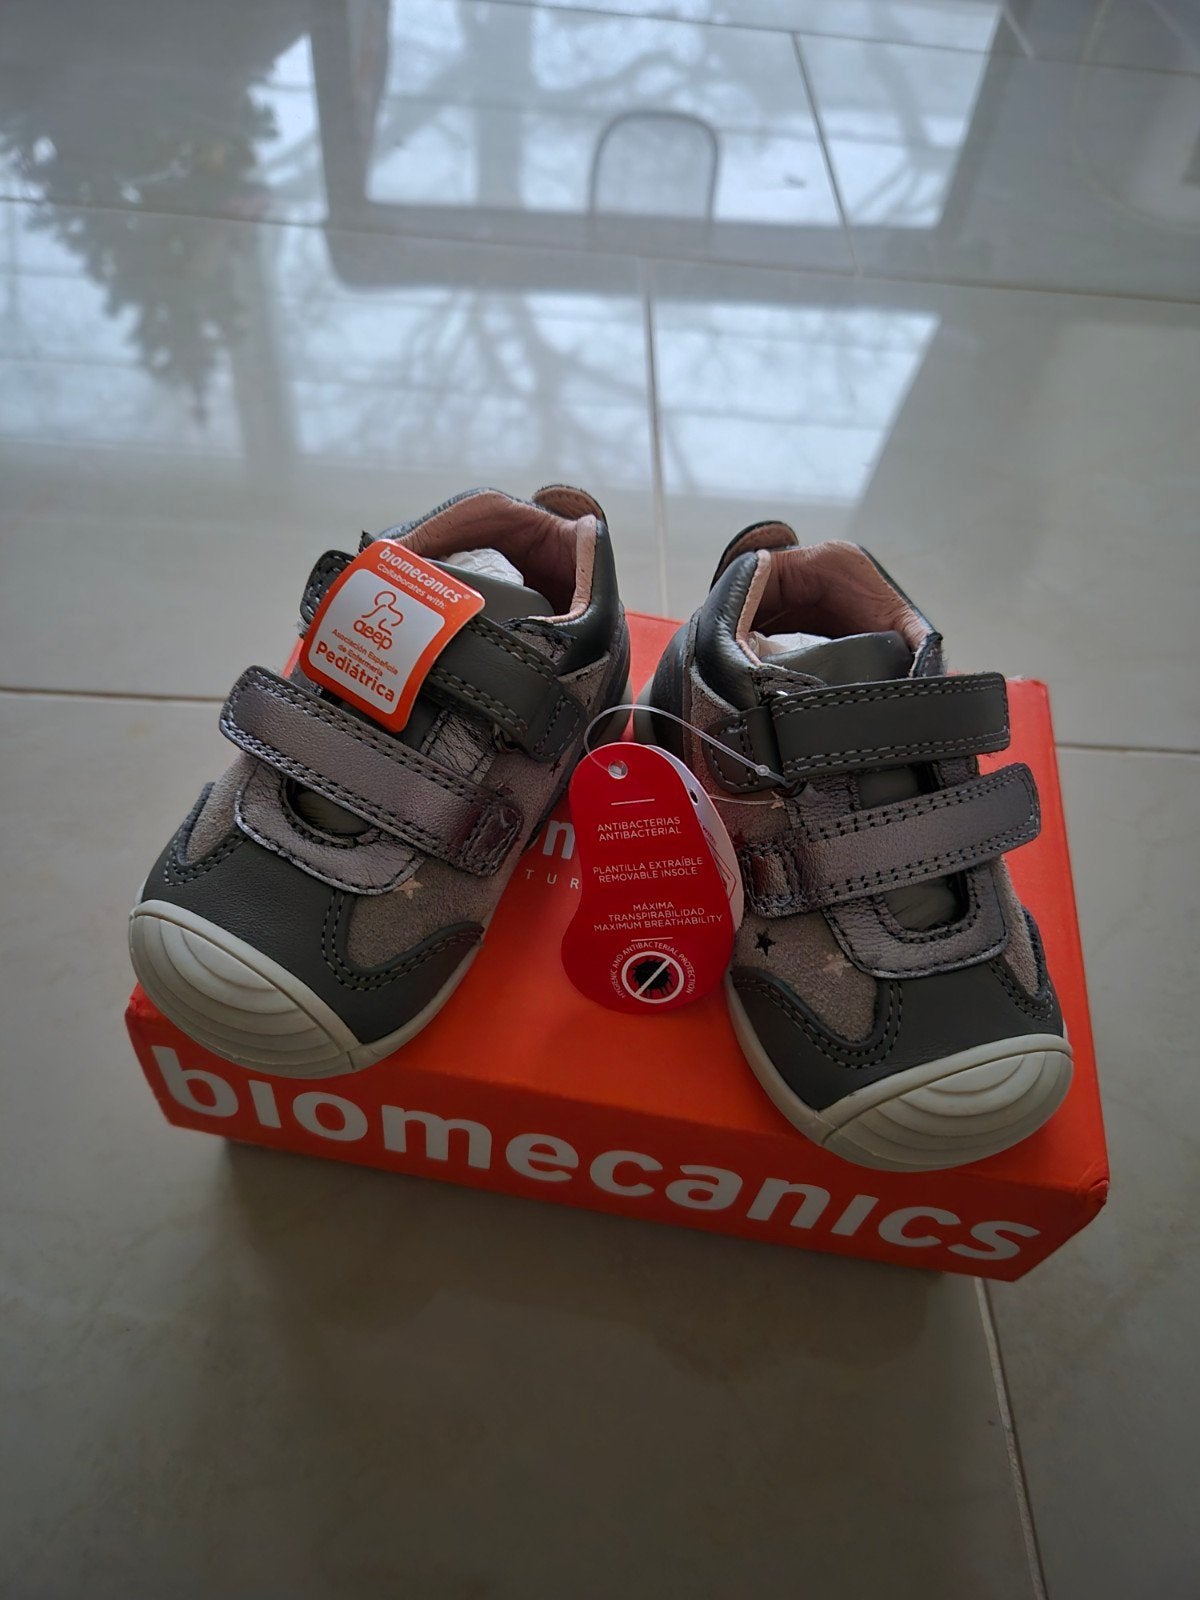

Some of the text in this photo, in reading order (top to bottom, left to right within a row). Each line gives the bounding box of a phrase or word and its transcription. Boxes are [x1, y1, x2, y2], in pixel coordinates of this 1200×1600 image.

[377, 563, 425, 596] Collaborates
[379, 545, 462, 603] biomecanics
[353, 620, 393, 650] aeep
[315, 640, 396, 703] Pediátrica
[597, 816, 681, 832] ANTIBACTERIAS
[598, 826, 682, 842] ANTIBACTERIAL
[593, 856, 704, 875] PLANTILLA EXTRAÍBLE
[599, 867, 698, 883] REMOVABLE INSOLE
[593, 915, 723, 932] MAXIMUM BREATHABILITY
[608, 907, 705, 922] TRANSPIRABILIDAD
[612, 954, 624, 969] AND
[622, 941, 679, 957] ANTIBACTERIAL
[678, 954, 697, 995] PROTECTION
[151, 1044, 1042, 1263] biomecanics
